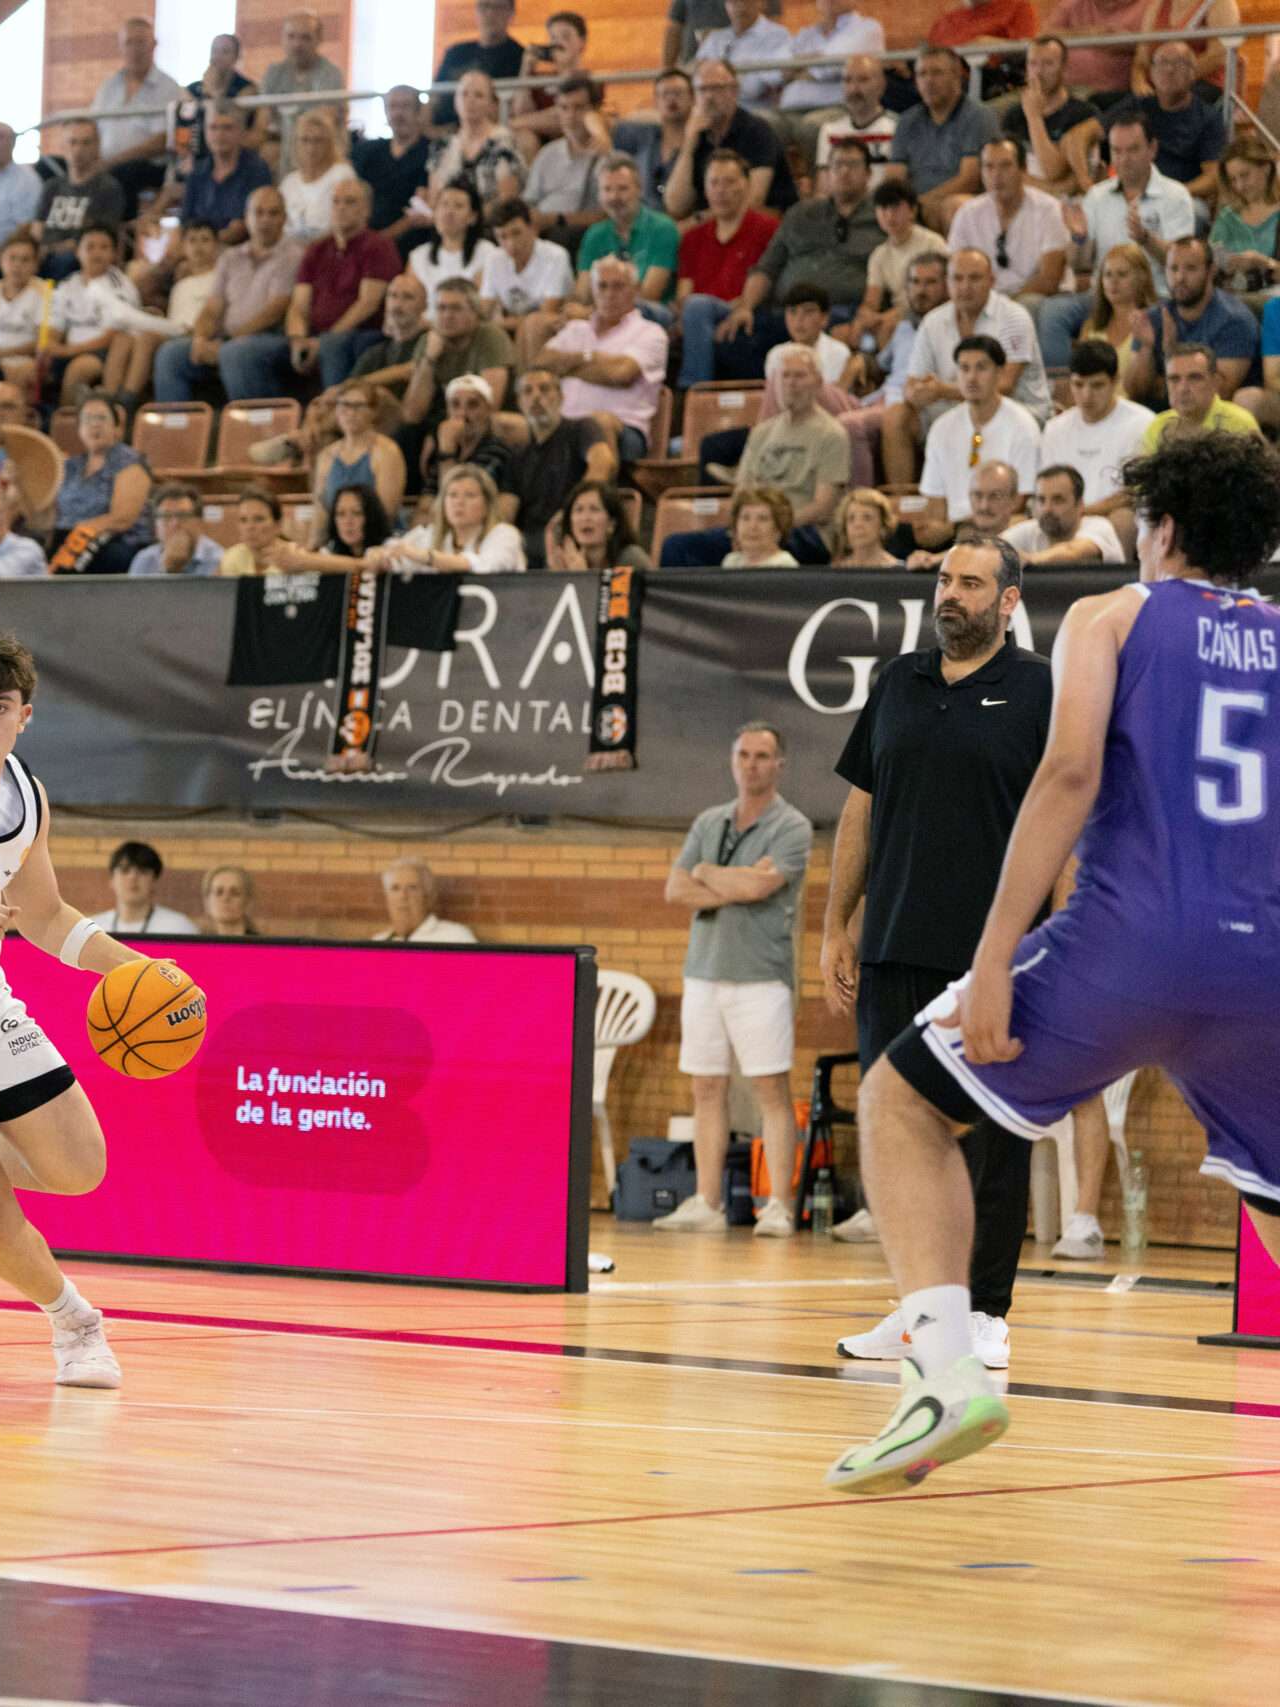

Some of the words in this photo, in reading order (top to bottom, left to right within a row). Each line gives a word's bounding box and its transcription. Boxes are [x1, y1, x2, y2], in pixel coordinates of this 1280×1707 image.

[601, 628, 628, 697] BCB
[1197, 615, 1278, 672] CAÑAS
[437, 699, 592, 735] DENTAL
[1195, 684, 1268, 825] 5
[237, 1065, 263, 1092] La
[267, 1067, 386, 1098] fundación
[235, 1099, 264, 1124] de
[271, 1101, 292, 1126] la
[298, 1107, 372, 1131] gente.
